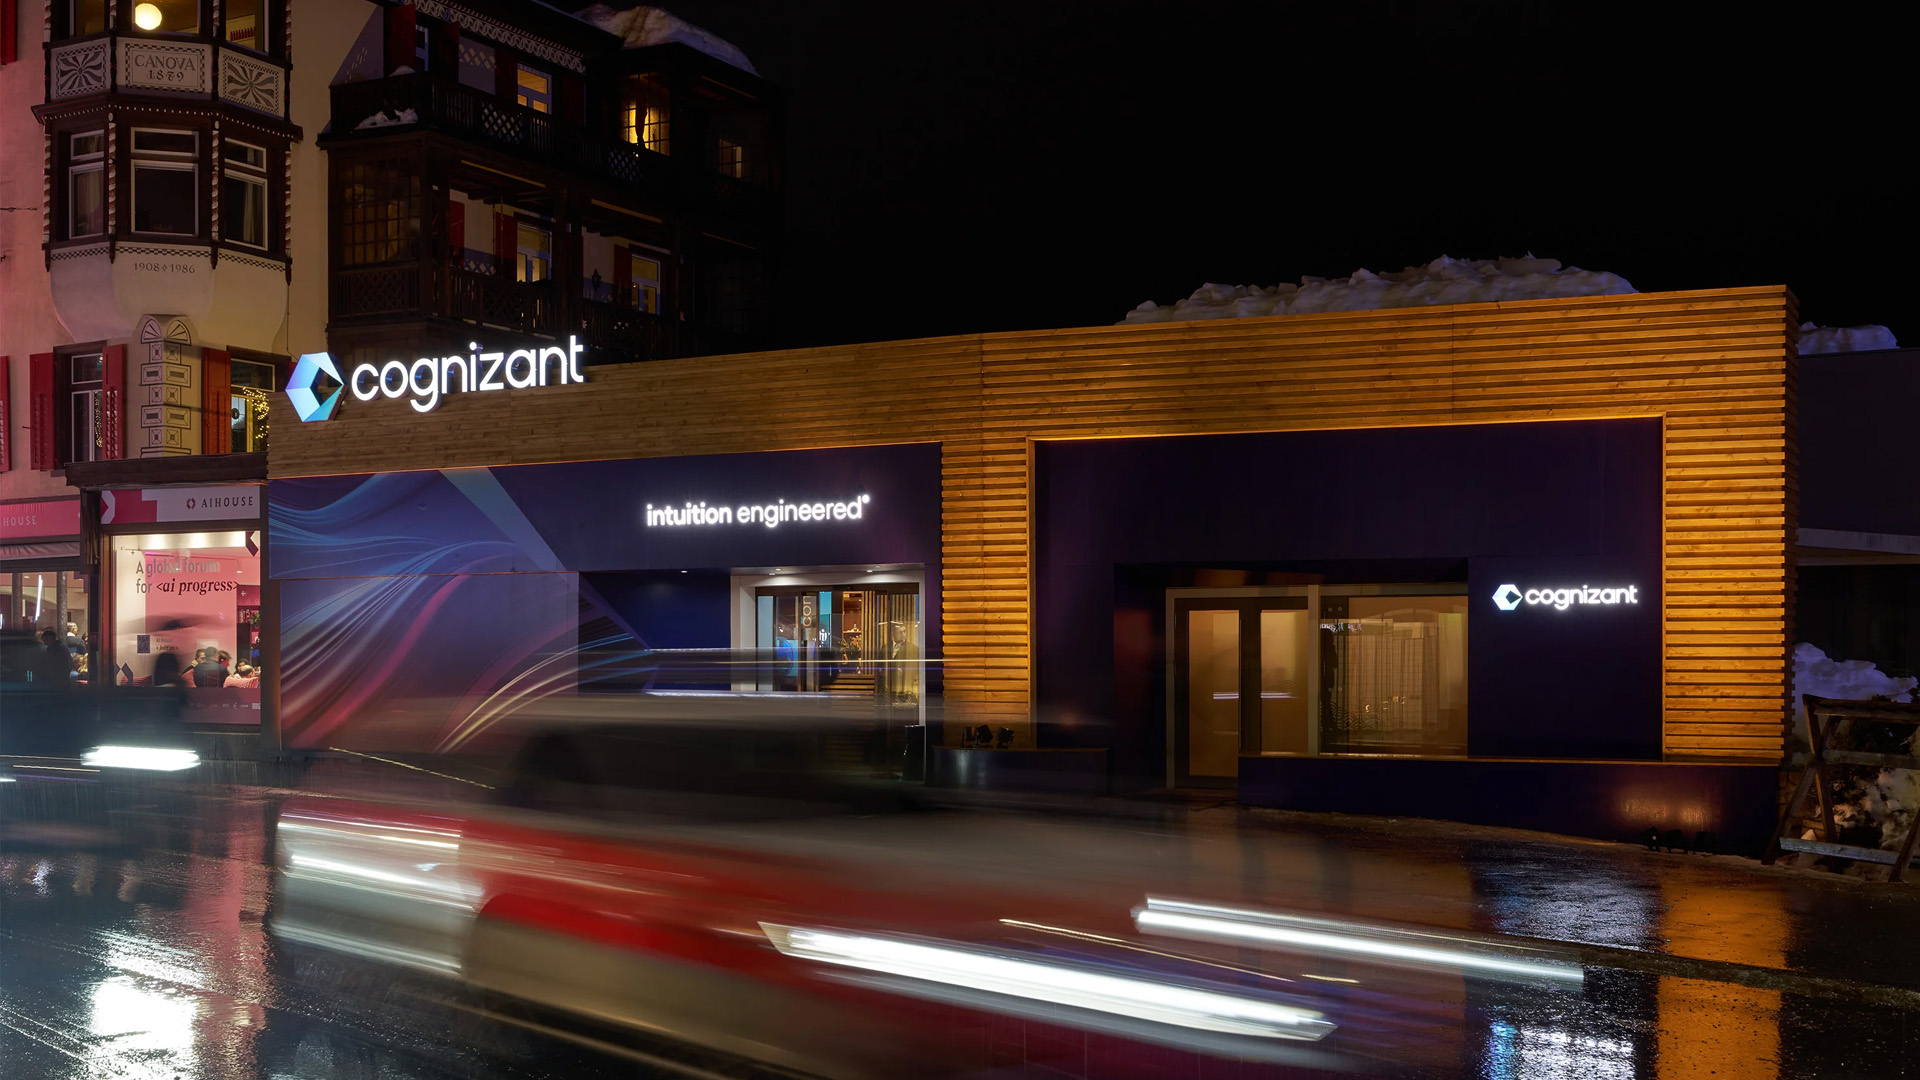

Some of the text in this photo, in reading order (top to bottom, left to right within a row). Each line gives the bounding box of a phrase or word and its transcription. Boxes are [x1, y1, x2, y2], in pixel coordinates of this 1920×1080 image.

[134, 54, 196, 71] CANOVA
[146, 70, 185, 82] 1879
[134, 262, 196, 274] 1908 1986
[351, 335, 584, 413] cognizant
[0, 515, 37, 527] HOUSE
[647, 502, 732, 527] intuition
[136, 557, 220, 578] A global forum
[136, 578, 153, 594] for
[1525, 584, 1638, 611] cognizant
